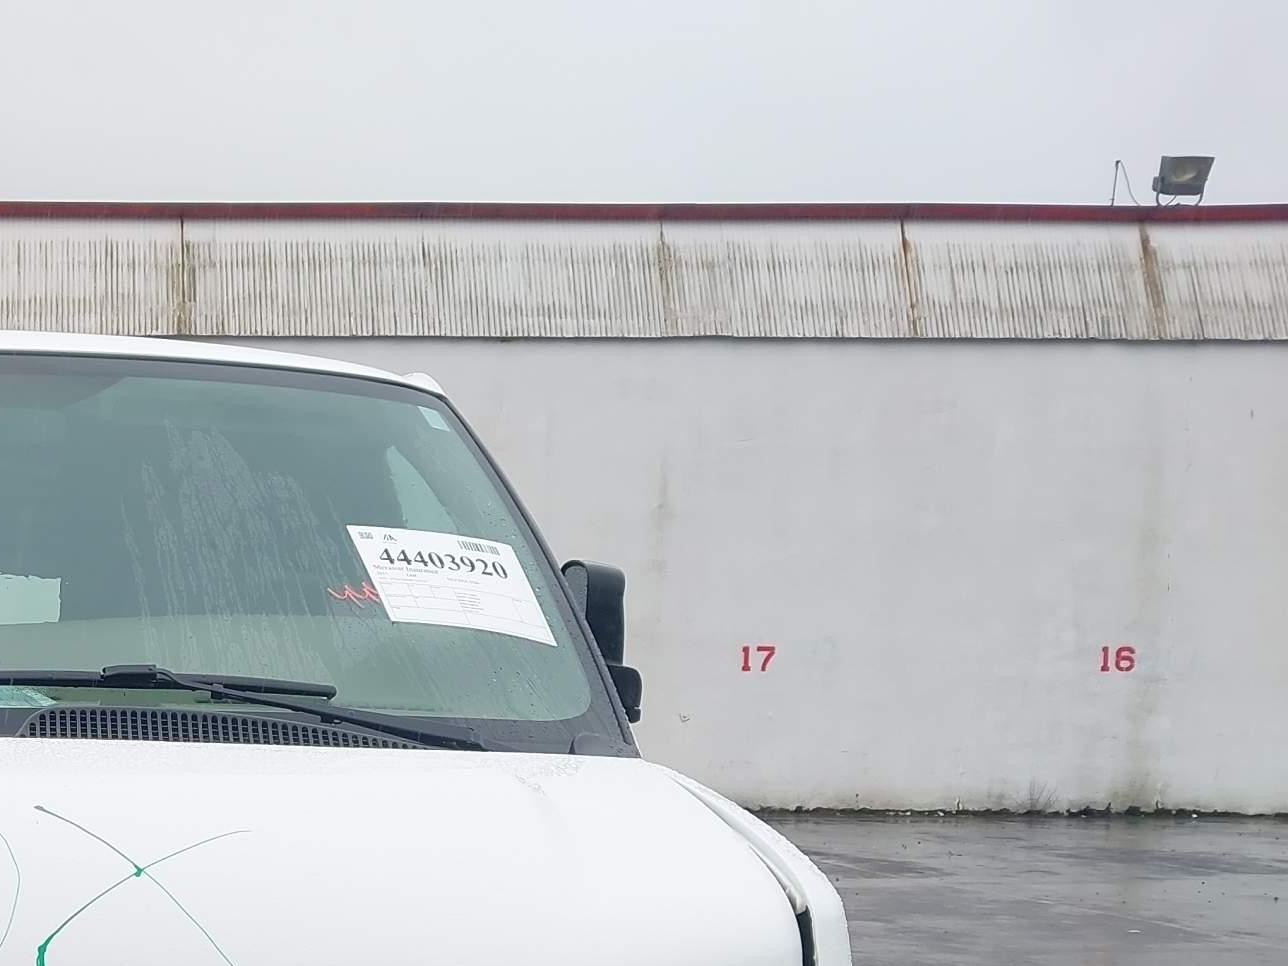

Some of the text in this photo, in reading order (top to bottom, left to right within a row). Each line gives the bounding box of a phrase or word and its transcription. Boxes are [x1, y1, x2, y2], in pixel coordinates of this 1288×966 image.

[379, 547, 509, 580] 44403920
[741, 645, 776, 672] 17
[1100, 645, 1136, 672] 16
